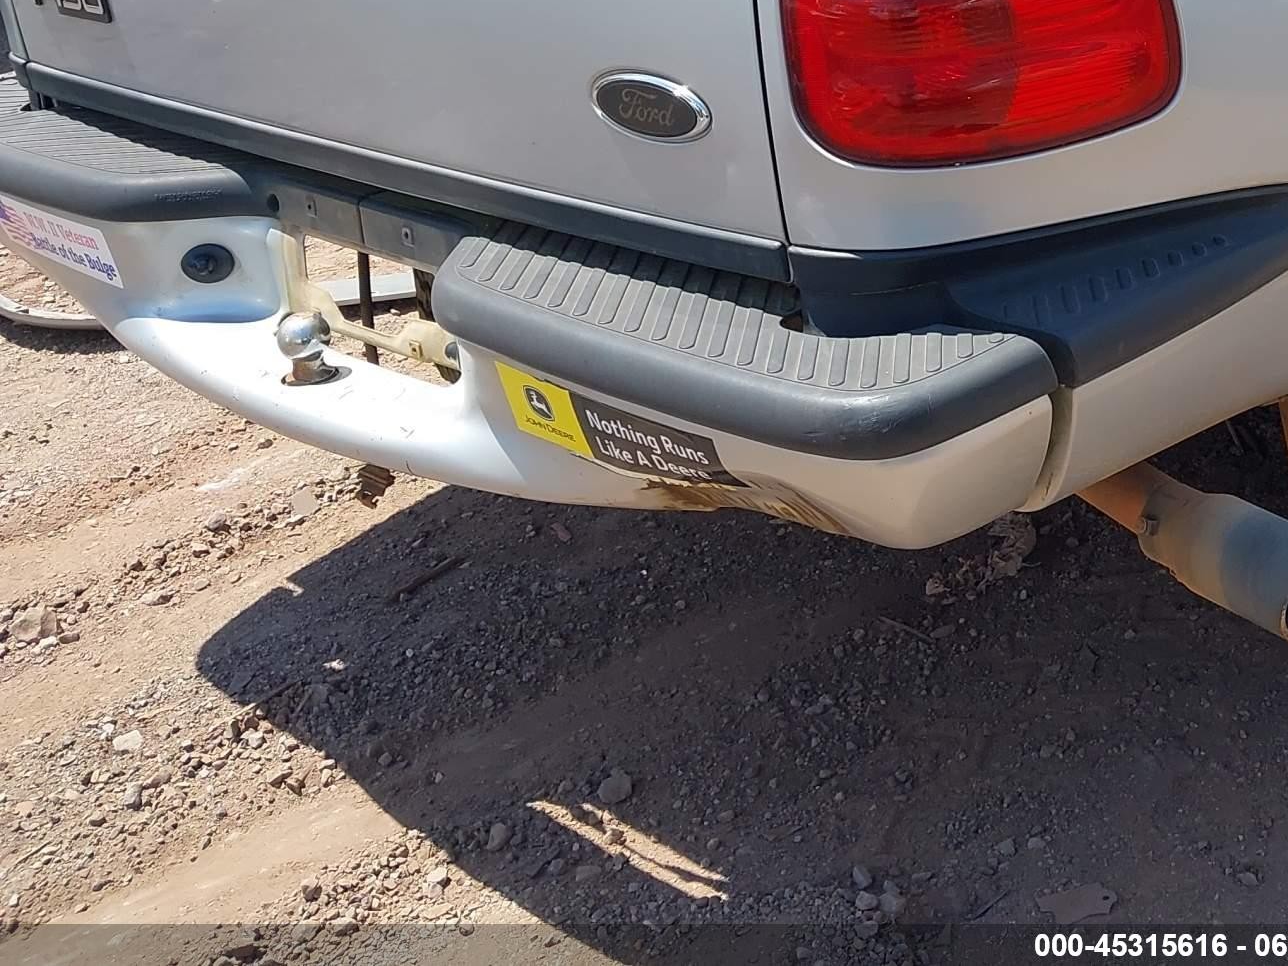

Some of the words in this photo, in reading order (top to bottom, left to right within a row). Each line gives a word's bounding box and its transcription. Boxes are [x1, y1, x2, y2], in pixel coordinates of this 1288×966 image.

[618, 88, 675, 127] Ford
[56, 223, 99, 251] Veteran
[58, 244, 70, 260] of
[68, 247, 87, 266] the
[84, 253, 117, 281] Bulge
[525, 415, 547, 432] JOHN
[584, 409, 662, 455] Nothing
[660, 434, 710, 466] Runs
[595, 435, 635, 465] Like
[636, 449, 653, 468] A
[651, 454, 713, 481] Deere
